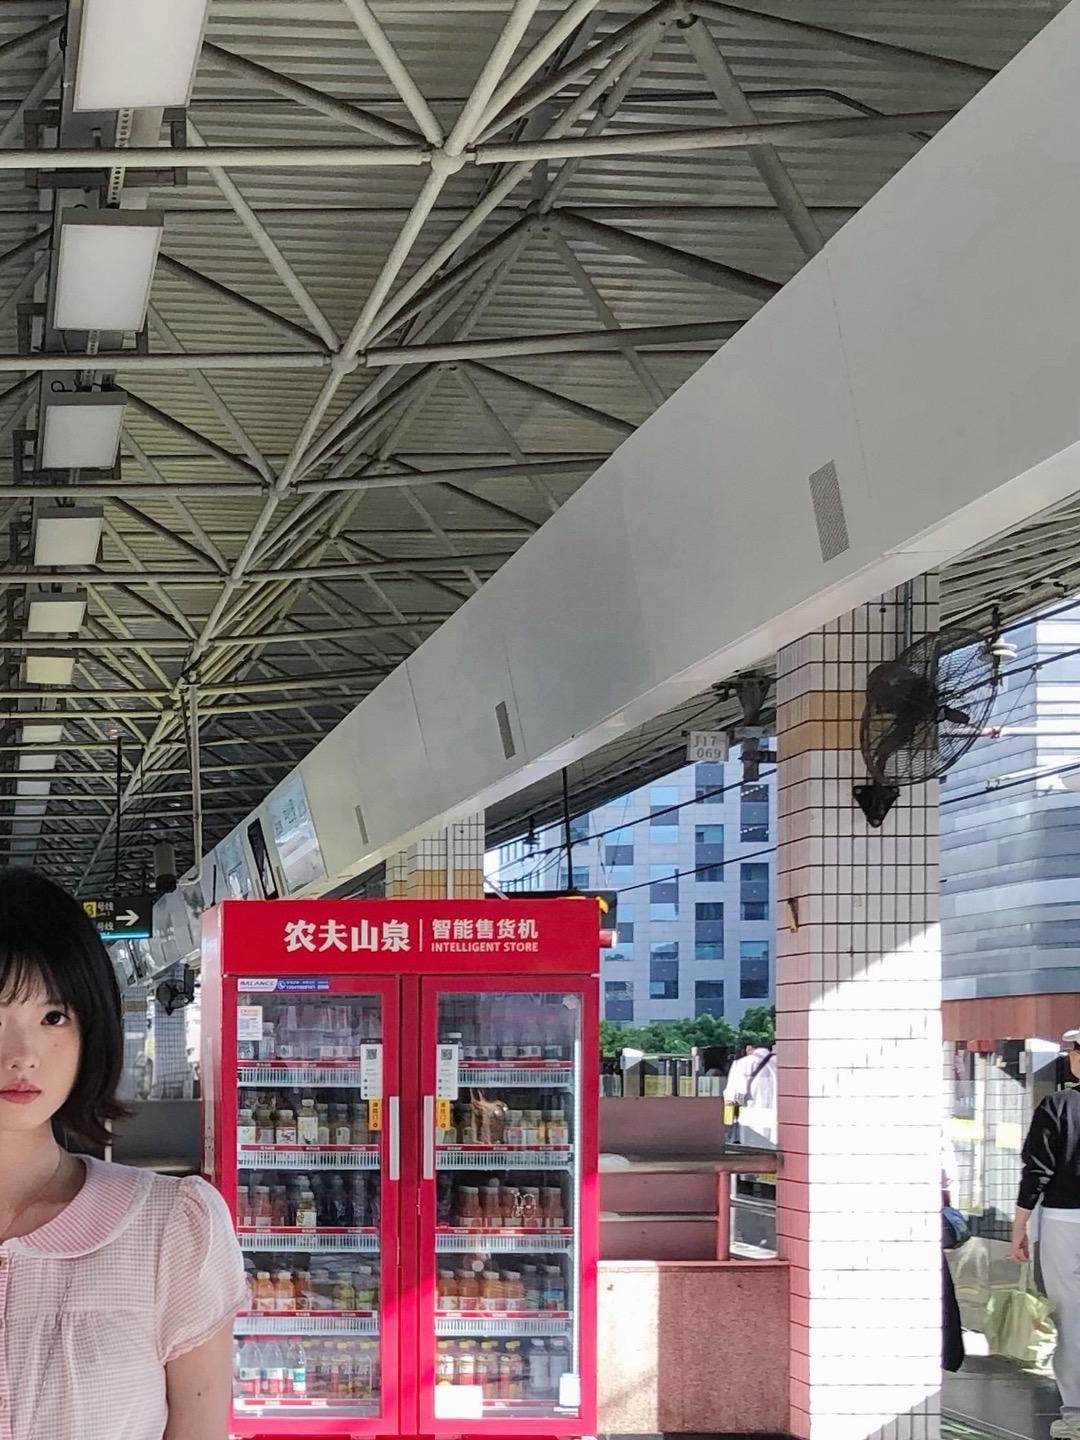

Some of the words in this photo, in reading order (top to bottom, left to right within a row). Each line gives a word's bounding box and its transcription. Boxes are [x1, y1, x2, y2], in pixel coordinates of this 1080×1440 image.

[696, 747, 721, 759] 069
[283, 919, 411, 953] 农夫山泉
[432, 919, 538, 940] 智能售货机
[431, 941, 500, 953] INTELLIGENT
[503, 941, 539, 953] STORE
